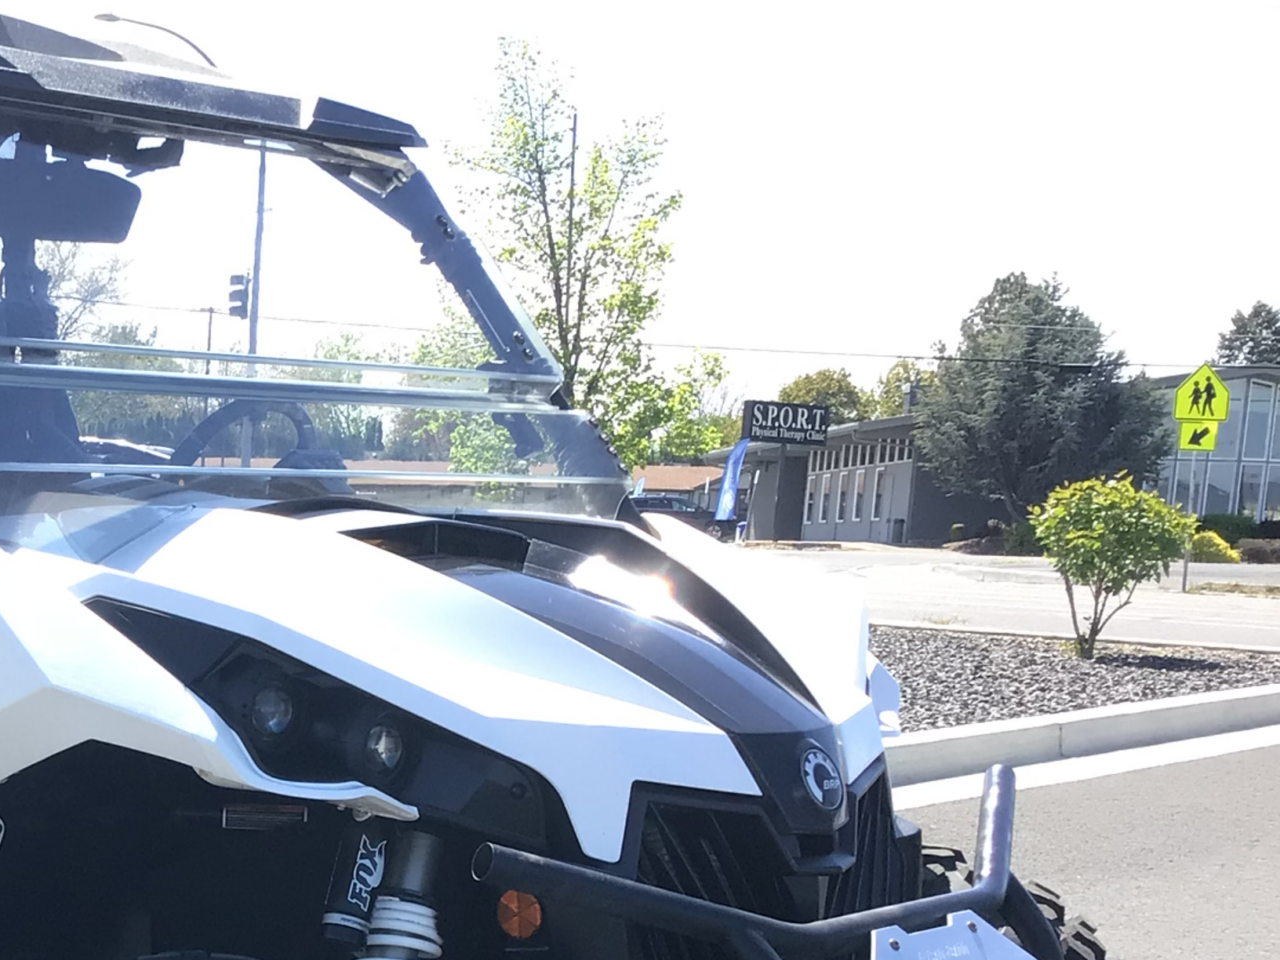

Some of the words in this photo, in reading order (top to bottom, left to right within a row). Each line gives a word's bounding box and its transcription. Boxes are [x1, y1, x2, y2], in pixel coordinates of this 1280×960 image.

[753, 404, 826, 431] S.P.O.R.T.
[752, 426, 778, 439] Physical
[779, 429, 805, 442] Therapy
[806, 430, 826, 441] Clinic
[823, 779, 841, 790] BRP
[347, 834, 388, 912] FOX
